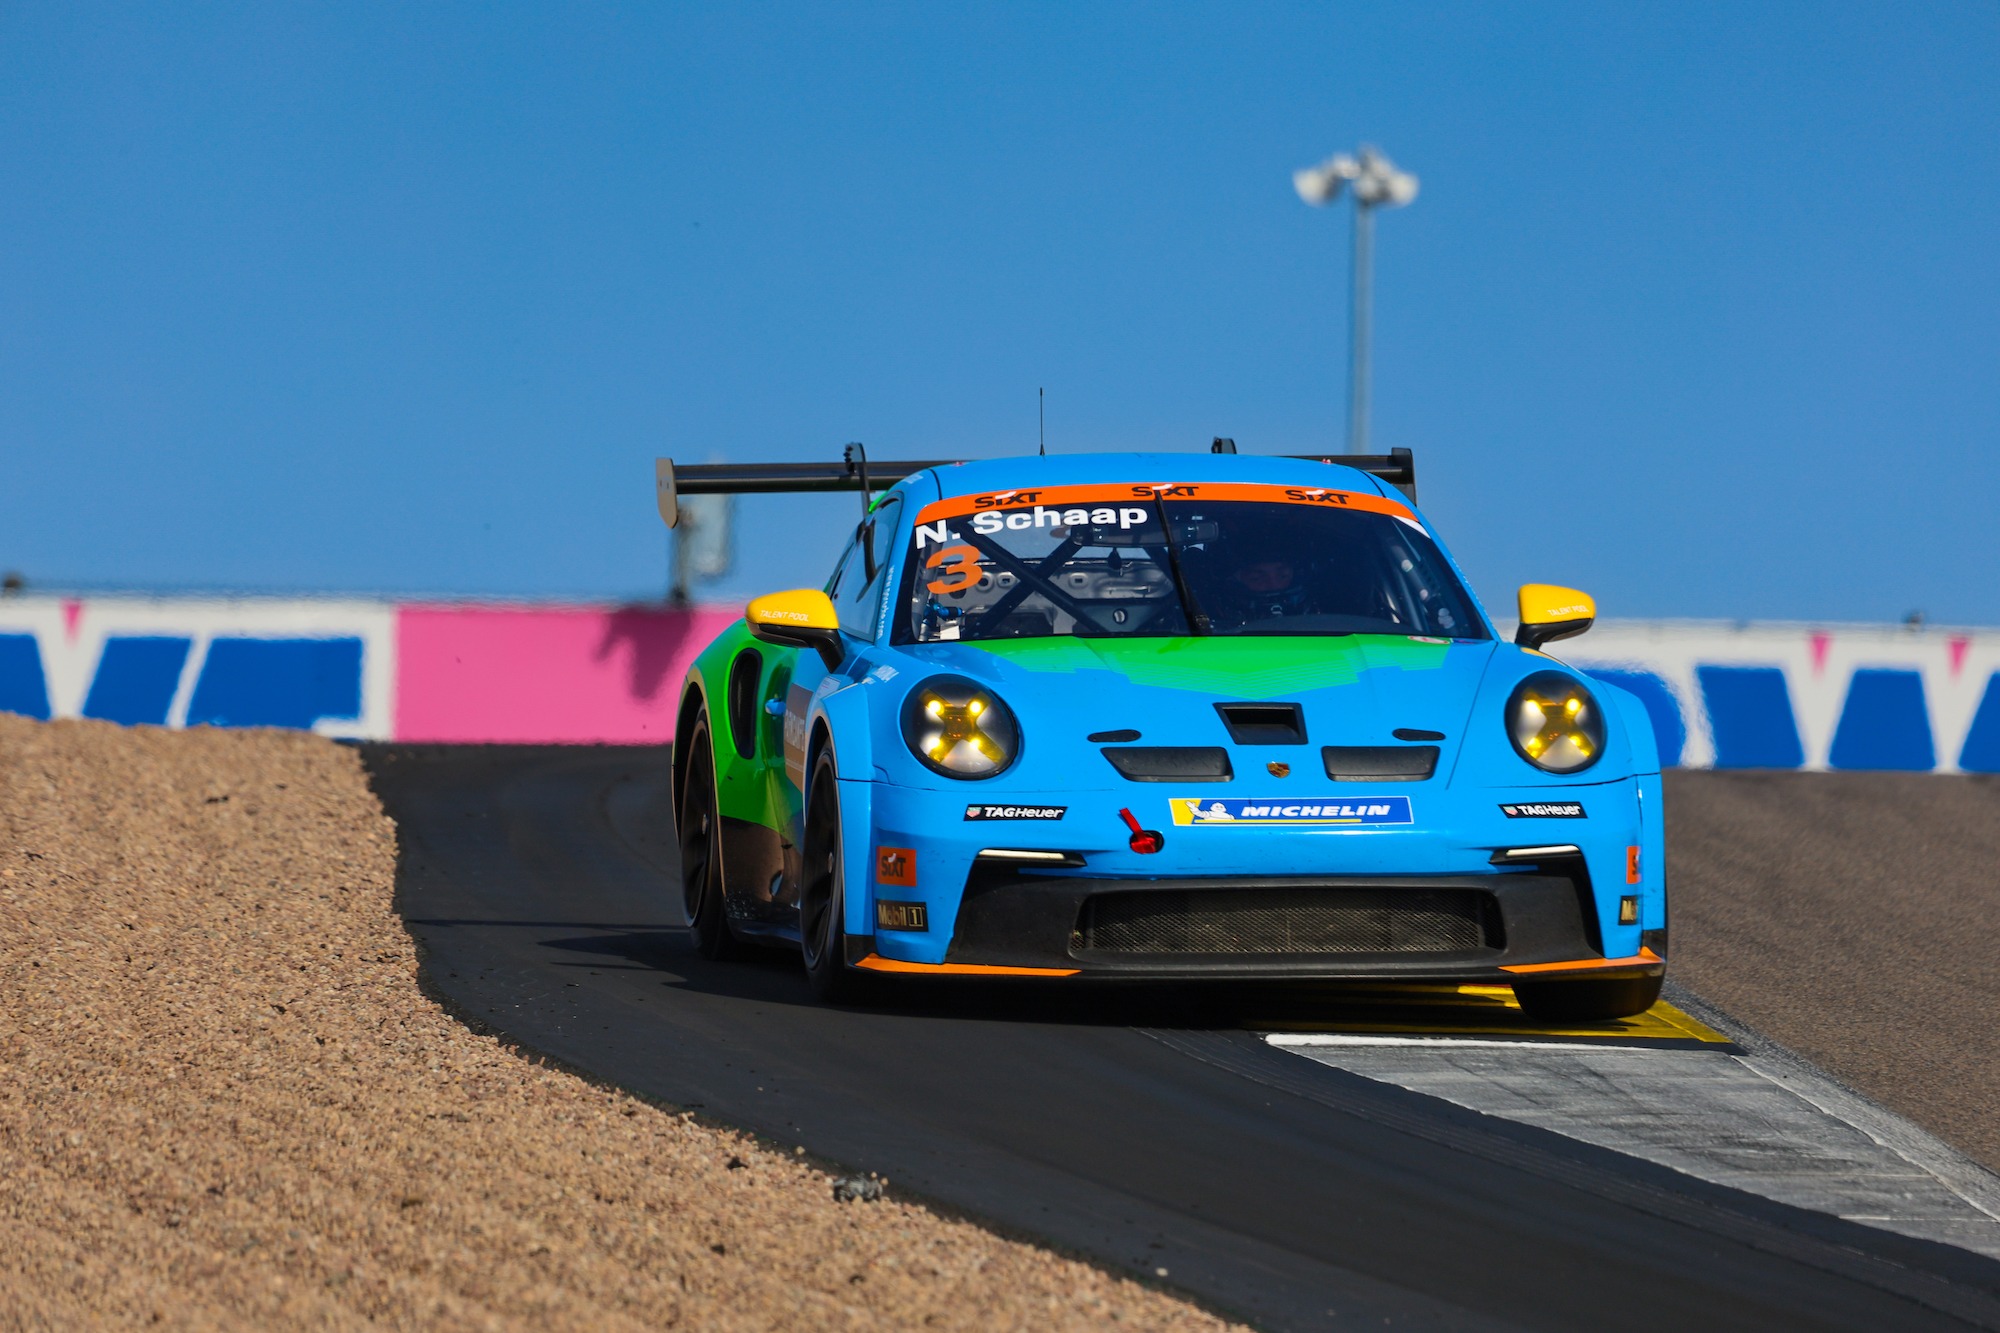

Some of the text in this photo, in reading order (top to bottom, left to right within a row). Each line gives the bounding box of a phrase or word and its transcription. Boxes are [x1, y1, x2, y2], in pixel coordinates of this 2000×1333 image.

[915, 505, 1148, 550] N. Schaap
[925, 545, 983, 594] 3
[761, 610, 809, 621] TALENT POOL
[1240, 804, 1391, 817] MICHELIN
[877, 903, 907, 927] Mobil
